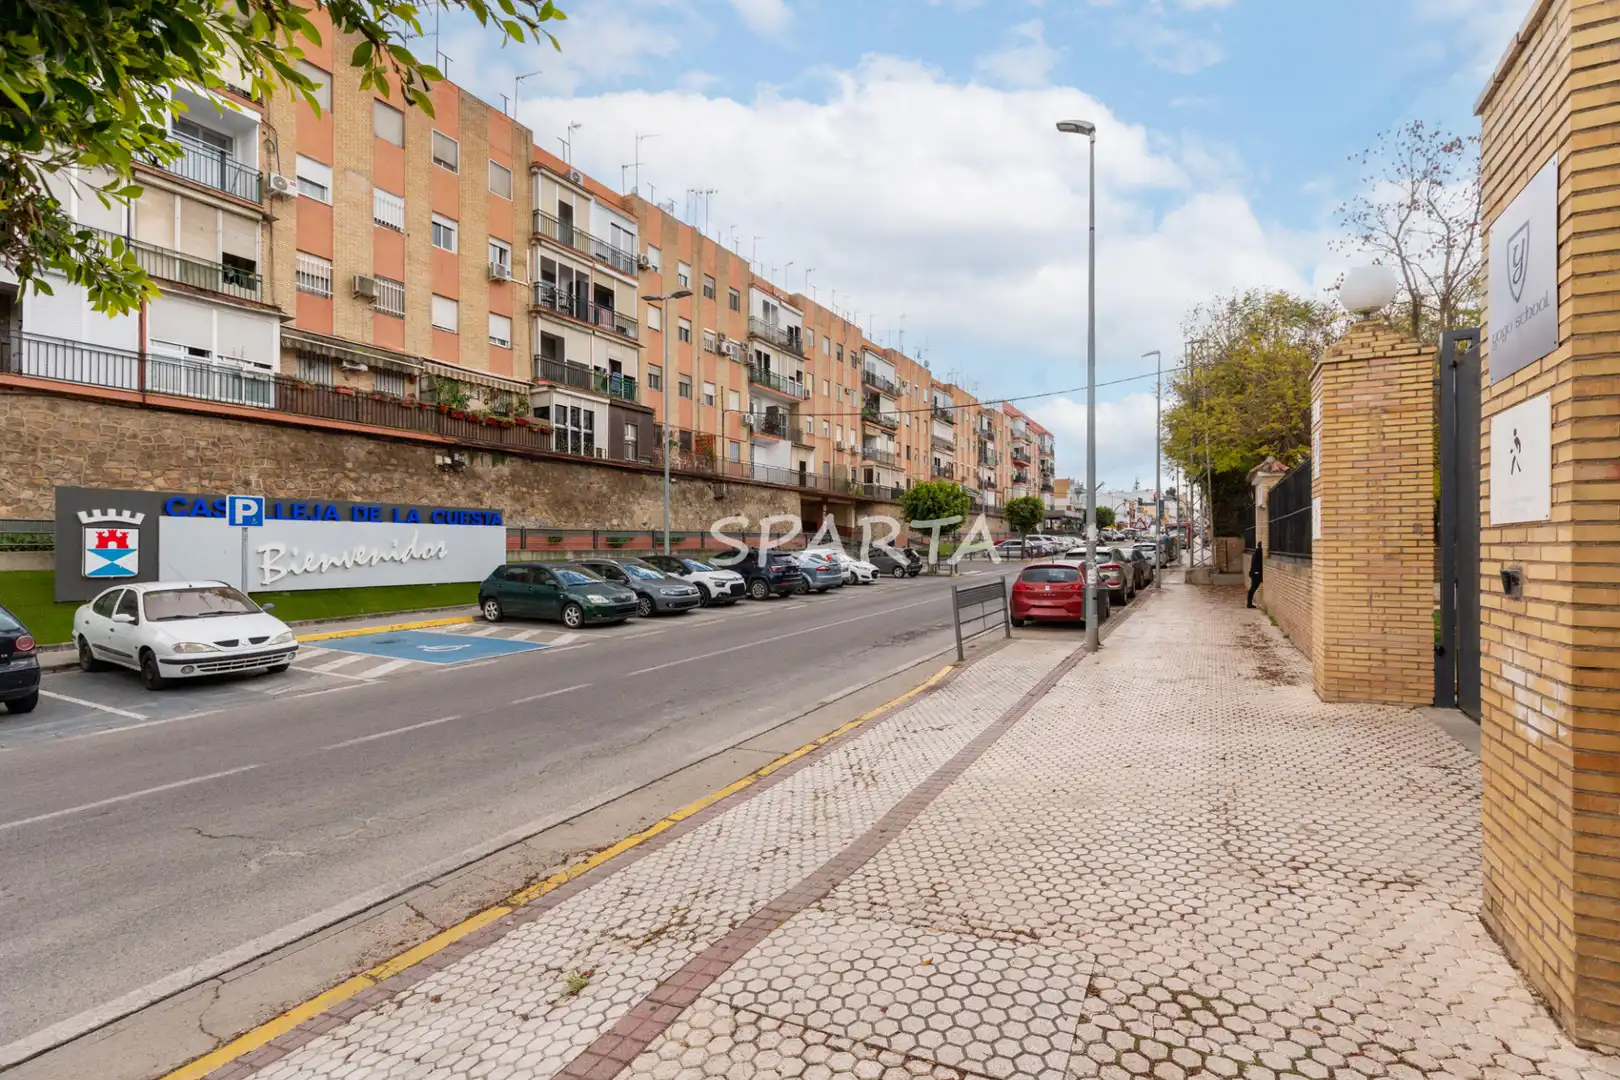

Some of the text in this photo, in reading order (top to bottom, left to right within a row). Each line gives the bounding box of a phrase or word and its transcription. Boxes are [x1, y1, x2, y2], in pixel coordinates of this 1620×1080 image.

[1491, 289, 1550, 351] yago school
[165, 496, 503, 526] CASLEJA DE LA CUESTA
[235, 498, 259, 525] P
[256, 528, 448, 586] Bienvenidos
